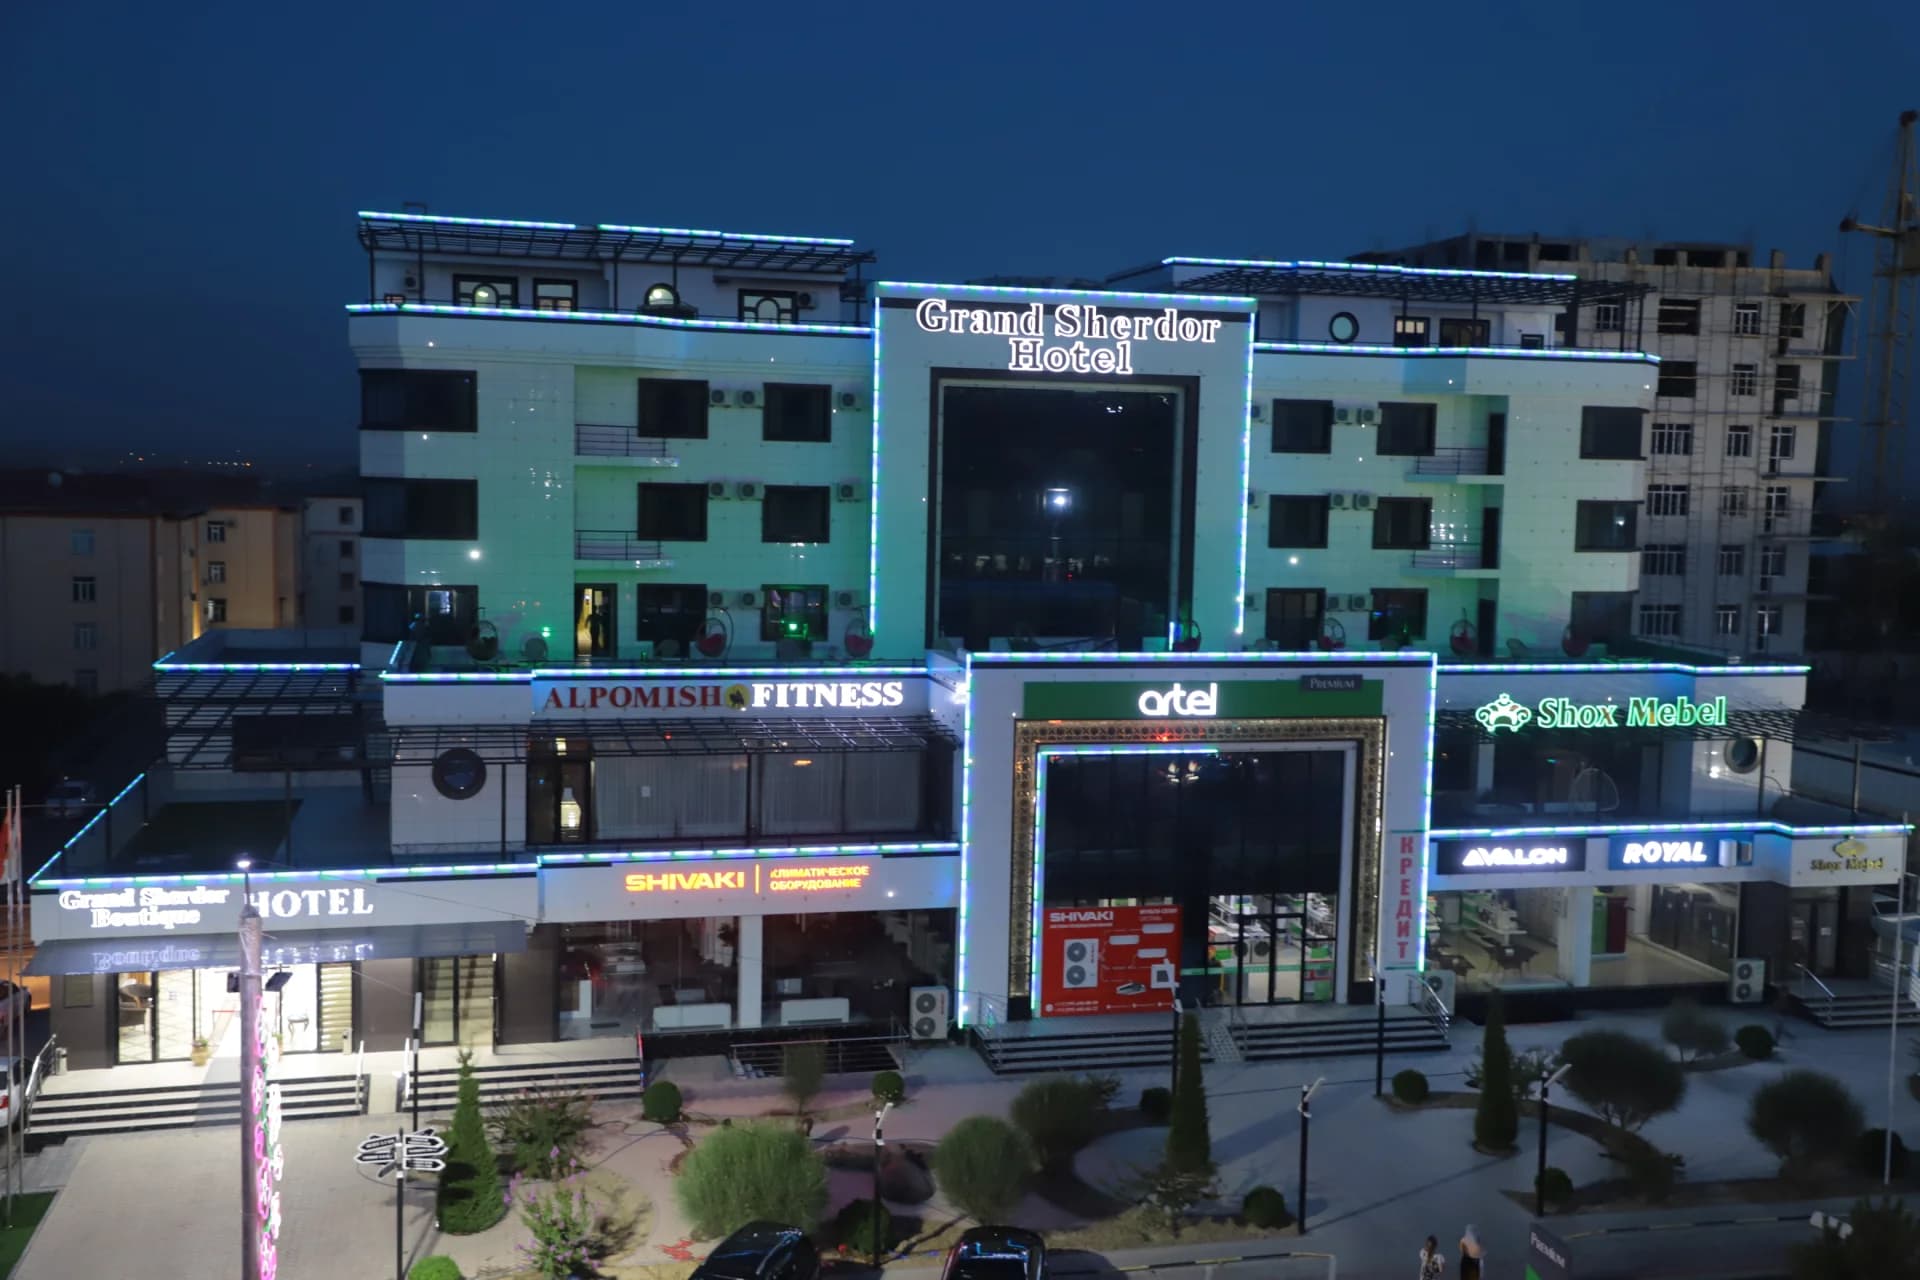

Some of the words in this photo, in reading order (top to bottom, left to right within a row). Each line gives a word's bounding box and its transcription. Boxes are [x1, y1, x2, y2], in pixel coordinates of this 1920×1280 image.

[916, 298, 1044, 337] Grand
[1054, 303, 1221, 343] Sherdor
[1008, 337, 1133, 374] Hotel
[544, 684, 722, 711] ALPOMISH
[751, 681, 904, 708] FITNESS
[1137, 682, 1218, 716] artel
[1537, 698, 1618, 728] Shox
[1626, 695, 1727, 727] Mebel
[1462, 847, 1568, 866] AVALON
[1622, 841, 1708, 864] ROYAL
[625, 871, 745, 892] SHIVAKI
[769, 878, 862, 891] ОБОРУДОВАНИЕ
[59, 888, 136, 910] Grand
[139, 886, 231, 906] Sherdor
[243, 888, 374, 918] HOTEL
[1395, 836, 1413, 959] КРЕДИТ
[90, 906, 201, 929] Boutique
[1050, 911, 1114, 922] SHIVAKI
